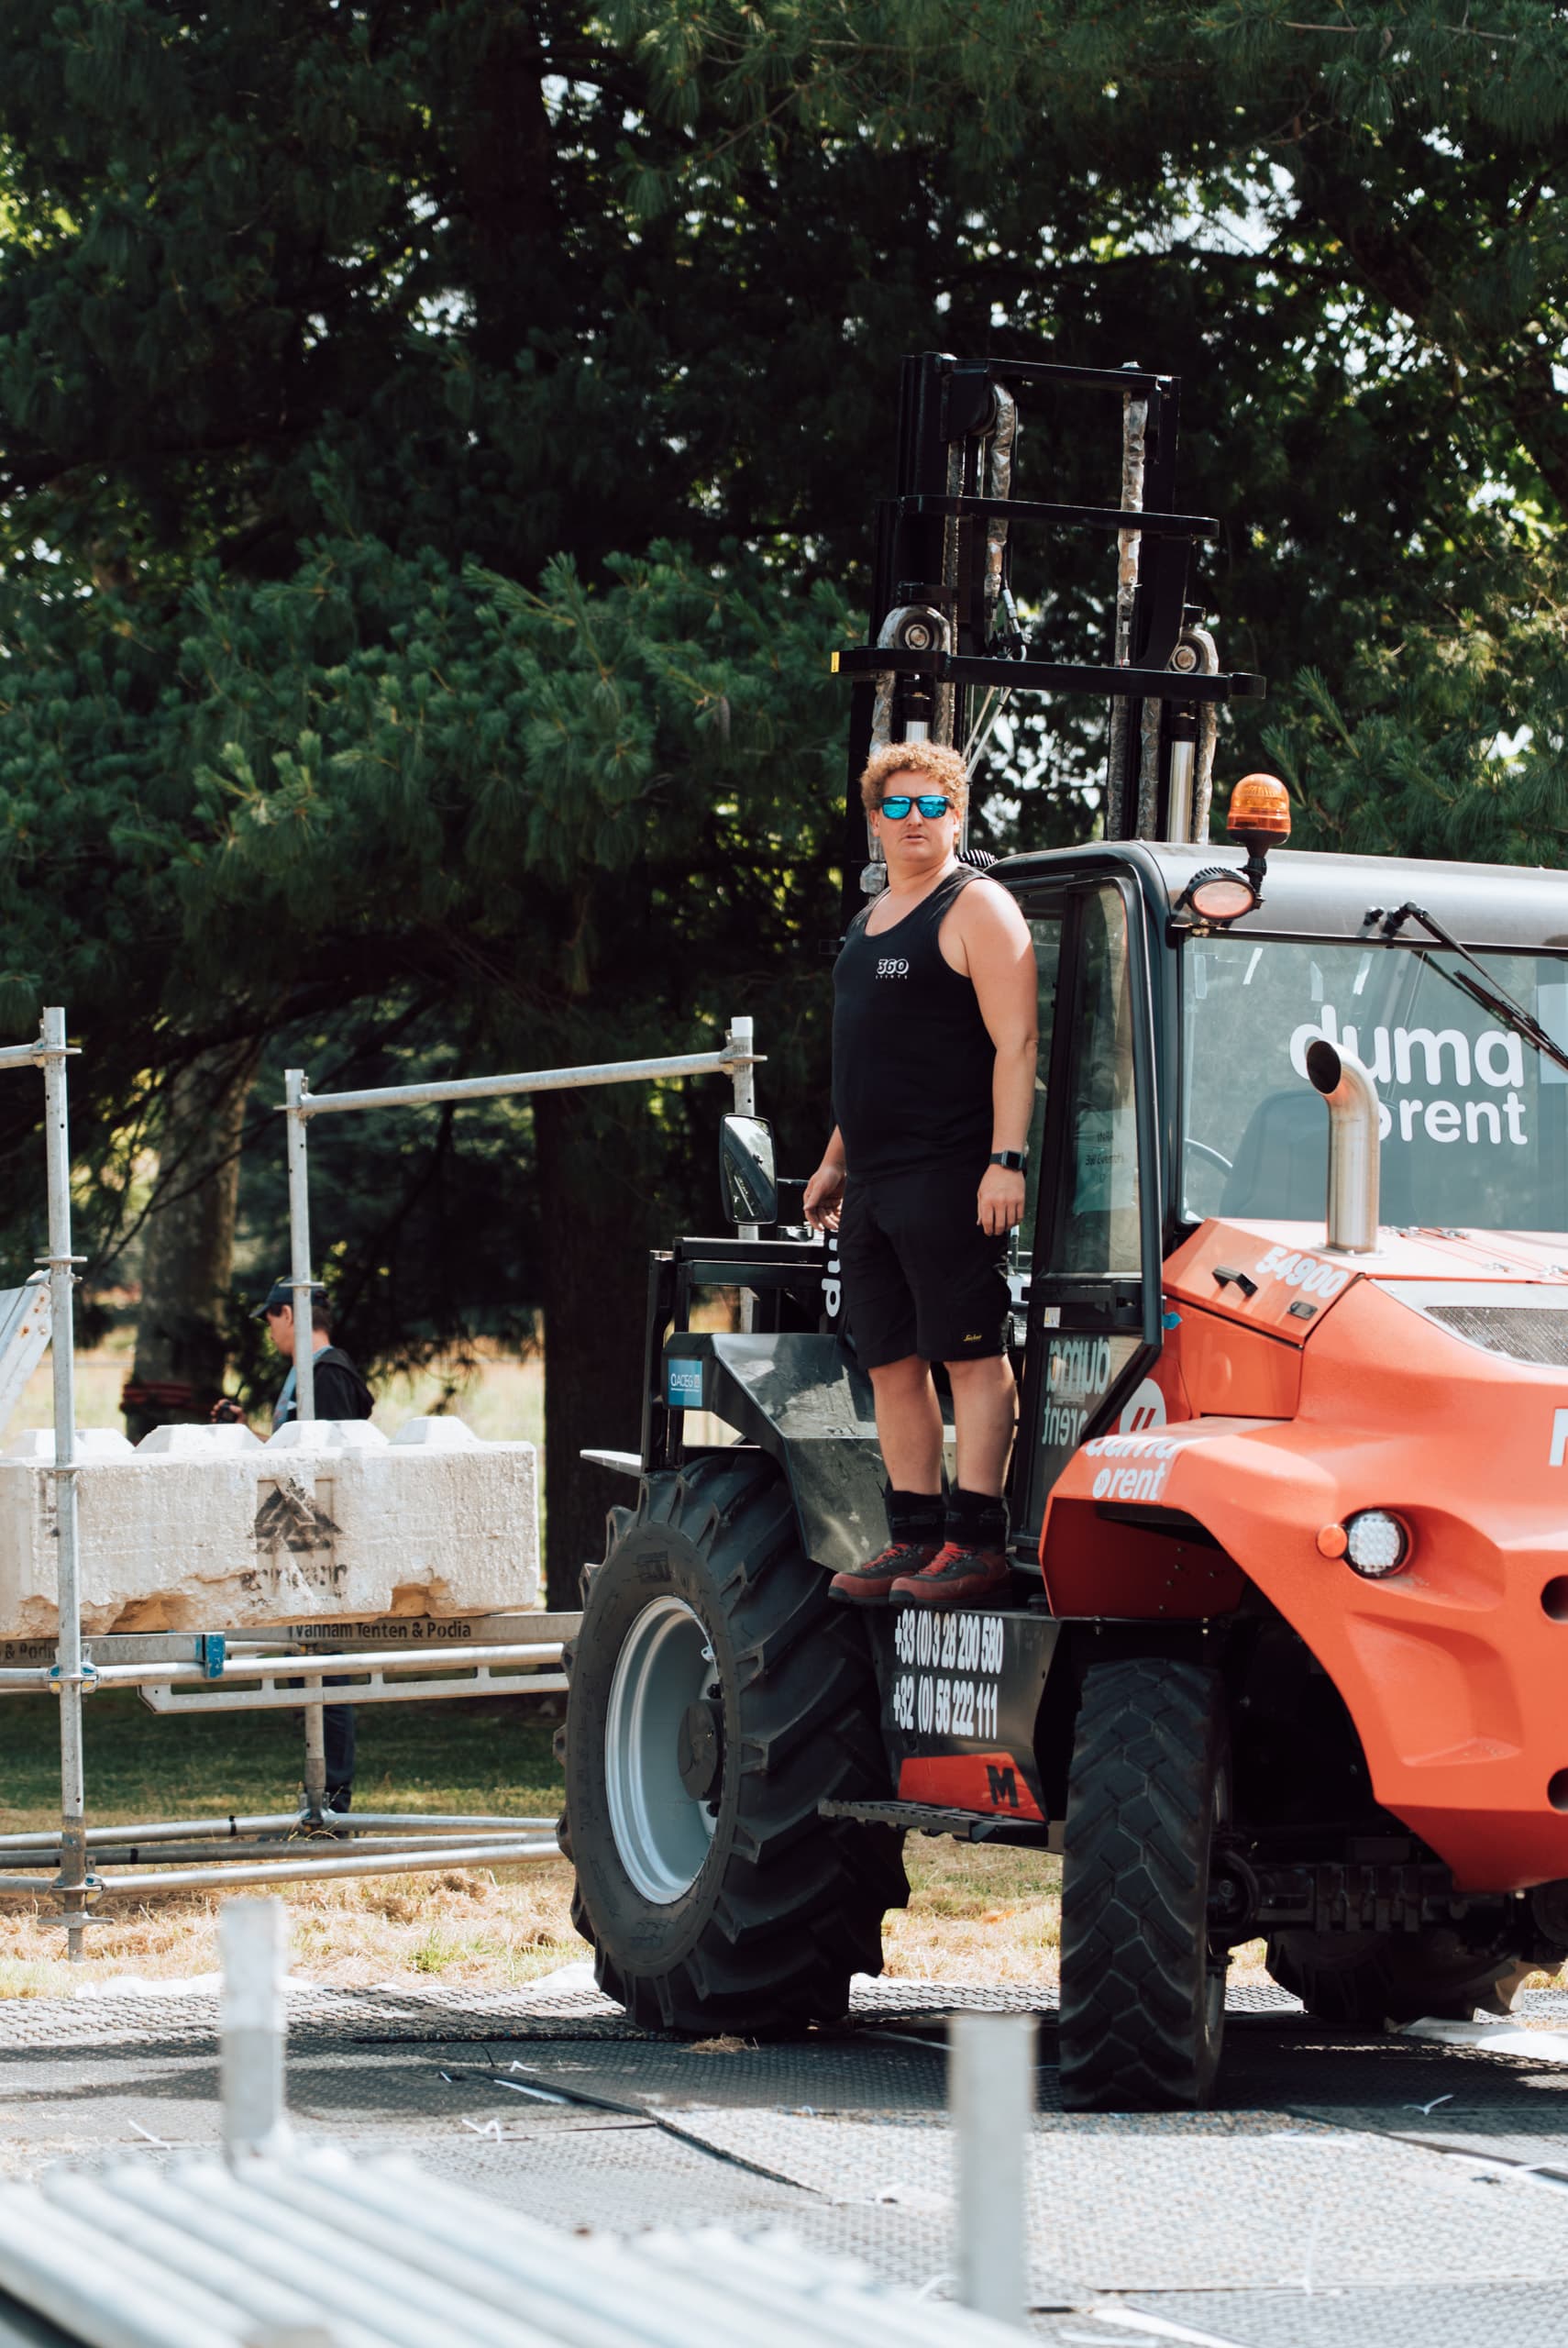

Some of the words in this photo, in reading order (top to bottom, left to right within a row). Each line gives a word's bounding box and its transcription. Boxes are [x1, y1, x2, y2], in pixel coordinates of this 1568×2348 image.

[877, 958, 909, 974] 360
[1289, 1004, 1524, 1088] duma
[1255, 1246, 1350, 1298] 54900
[1092, 1462, 1165, 1501] orent
[20, 1642, 56, 1659] Podi
[356, 1622, 407, 1638] Tenten
[412, 1622, 423, 1638] &
[427, 1620, 471, 1638] Podia
[895, 1609, 915, 1665] +33
[917, 1610, 932, 1667] (0)
[933, 1612, 941, 1667] 3
[941, 1613, 956, 1669] 28
[957, 1614, 980, 1672] 200
[981, 1617, 1004, 1675] 580
[893, 1675, 914, 1731] +32
[918, 1675, 934, 1734] (0)
[952, 1679, 975, 1737] 222
[977, 1681, 998, 1740] 111
[987, 1765, 1019, 1808] M
